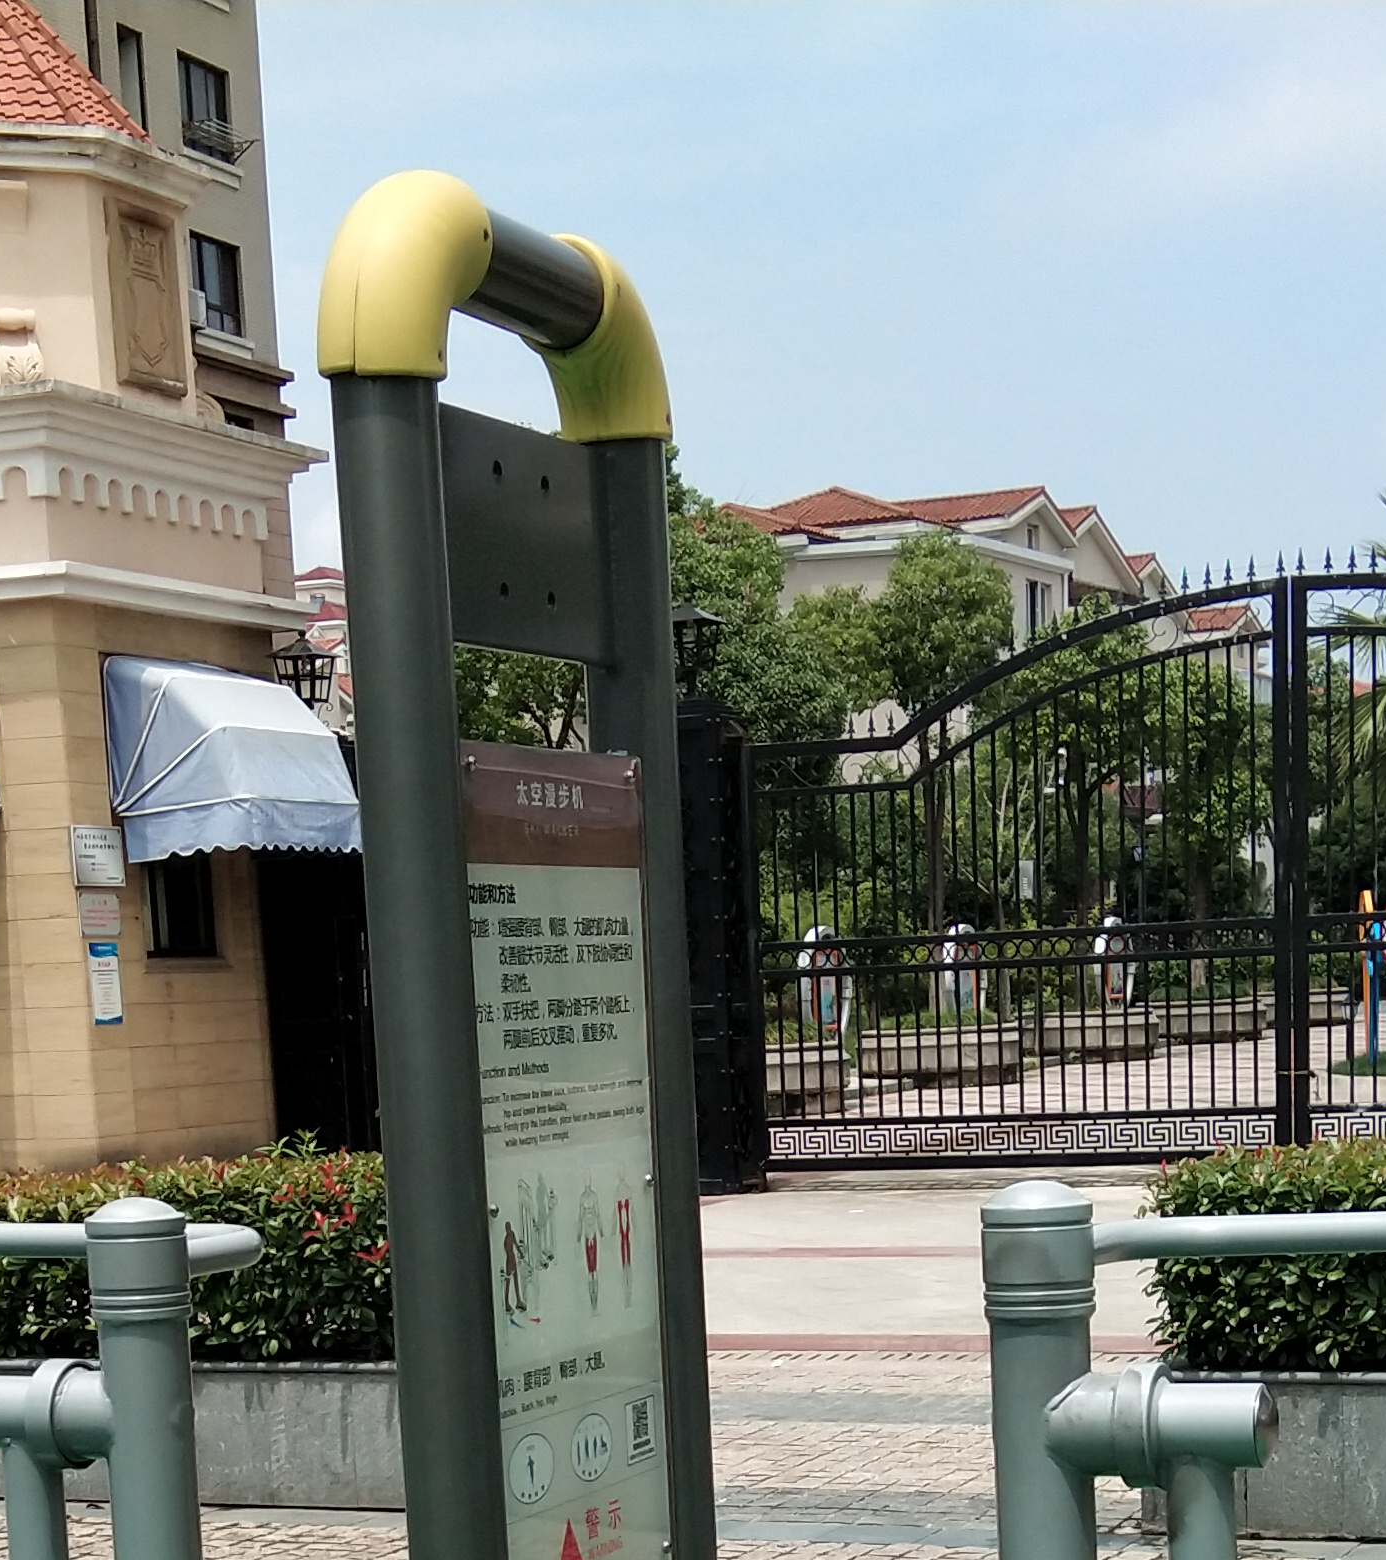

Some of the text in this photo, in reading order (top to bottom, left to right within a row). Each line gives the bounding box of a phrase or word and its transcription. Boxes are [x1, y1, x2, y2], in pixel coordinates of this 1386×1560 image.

[515, 779, 584, 810] 太空漫步机
[469, 883, 517, 905] 功能和方法
[480, 1067, 507, 1079] unction
[584, 1498, 622, 1541] 警示
